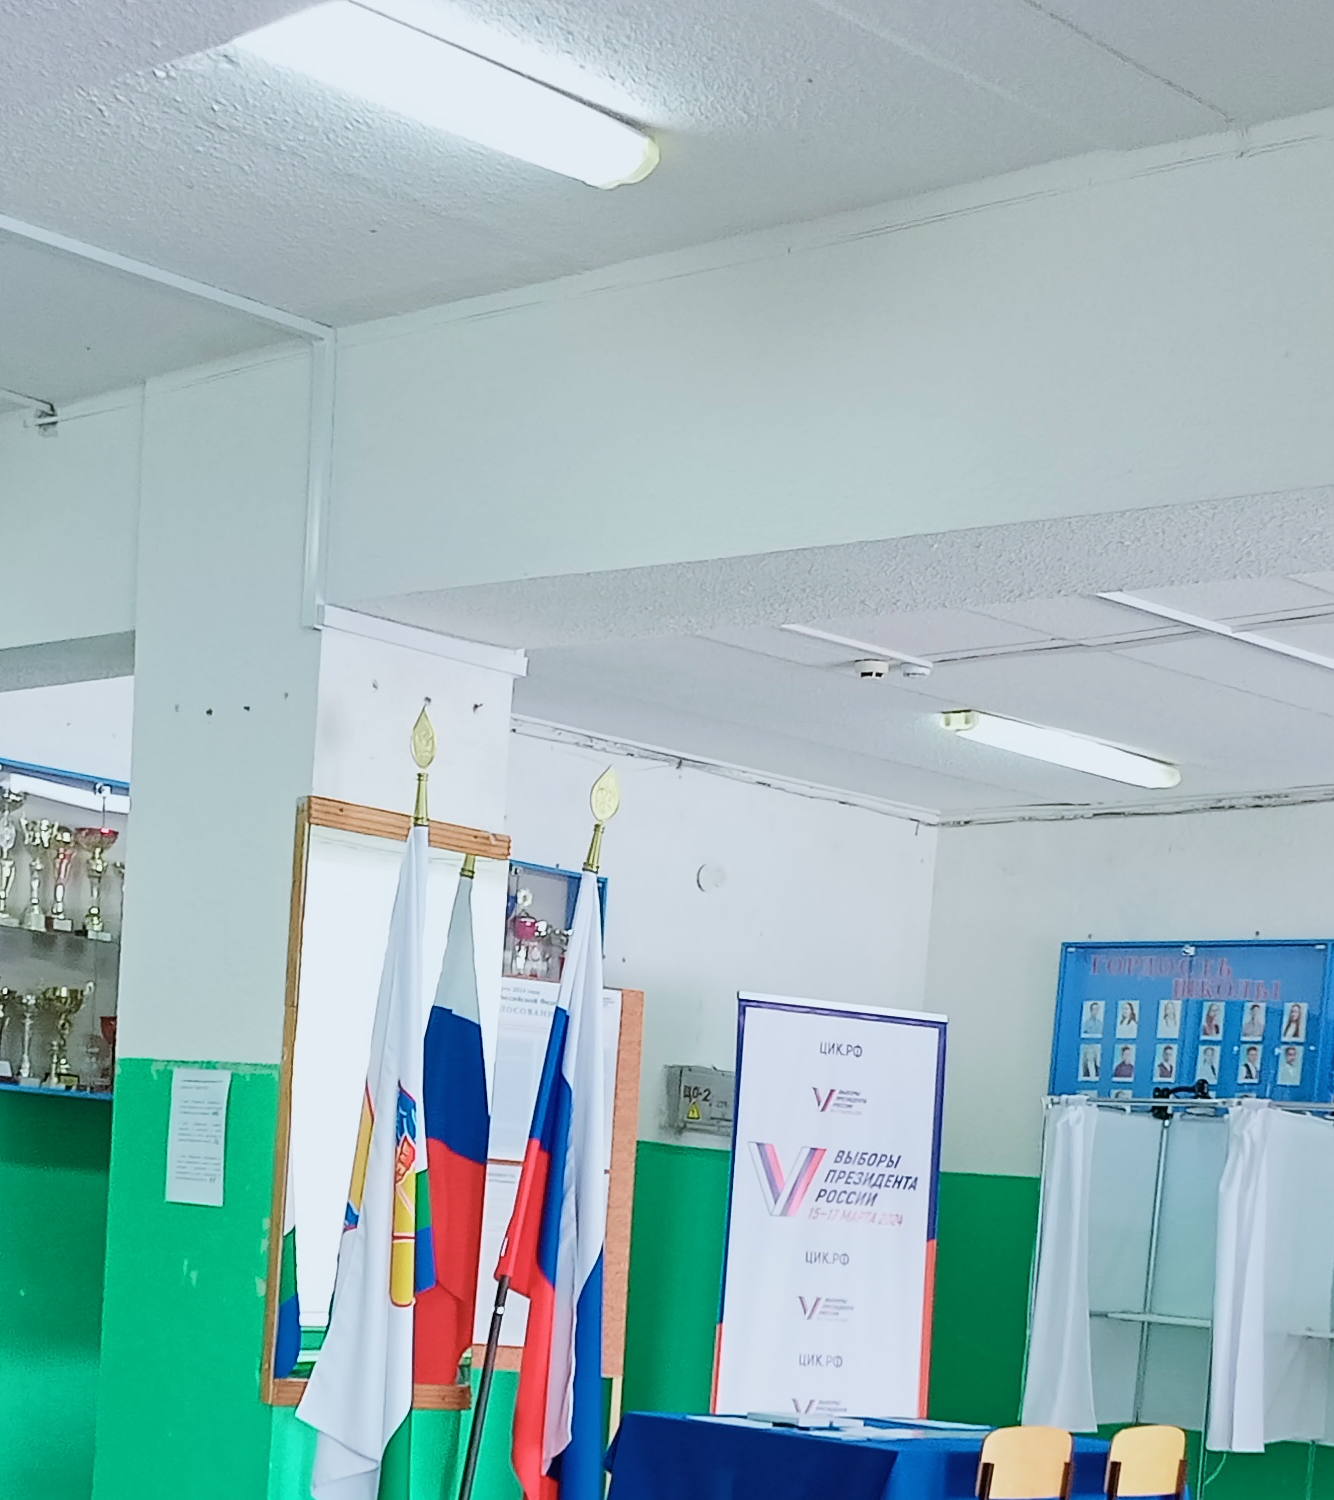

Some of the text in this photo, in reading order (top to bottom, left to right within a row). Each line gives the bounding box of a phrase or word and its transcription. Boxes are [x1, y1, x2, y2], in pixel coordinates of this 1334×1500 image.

[1090, 954, 1233, 976] ГОРДОСТЬ
[1173, 978, 1281, 1000] ШКОЛЫ
[819, 1041, 863, 1058] ЦИК.РФ
[833, 1150, 902, 1169] ВЫБОРЫ
[824, 1169, 919, 1191] ПРЕЗИДЕНТА
[815, 1189, 878, 1207] РОССИИ
[805, 1251, 850, 1266] ЦИК.РФ
[798, 1354, 843, 1368] ЦИК.РФ
